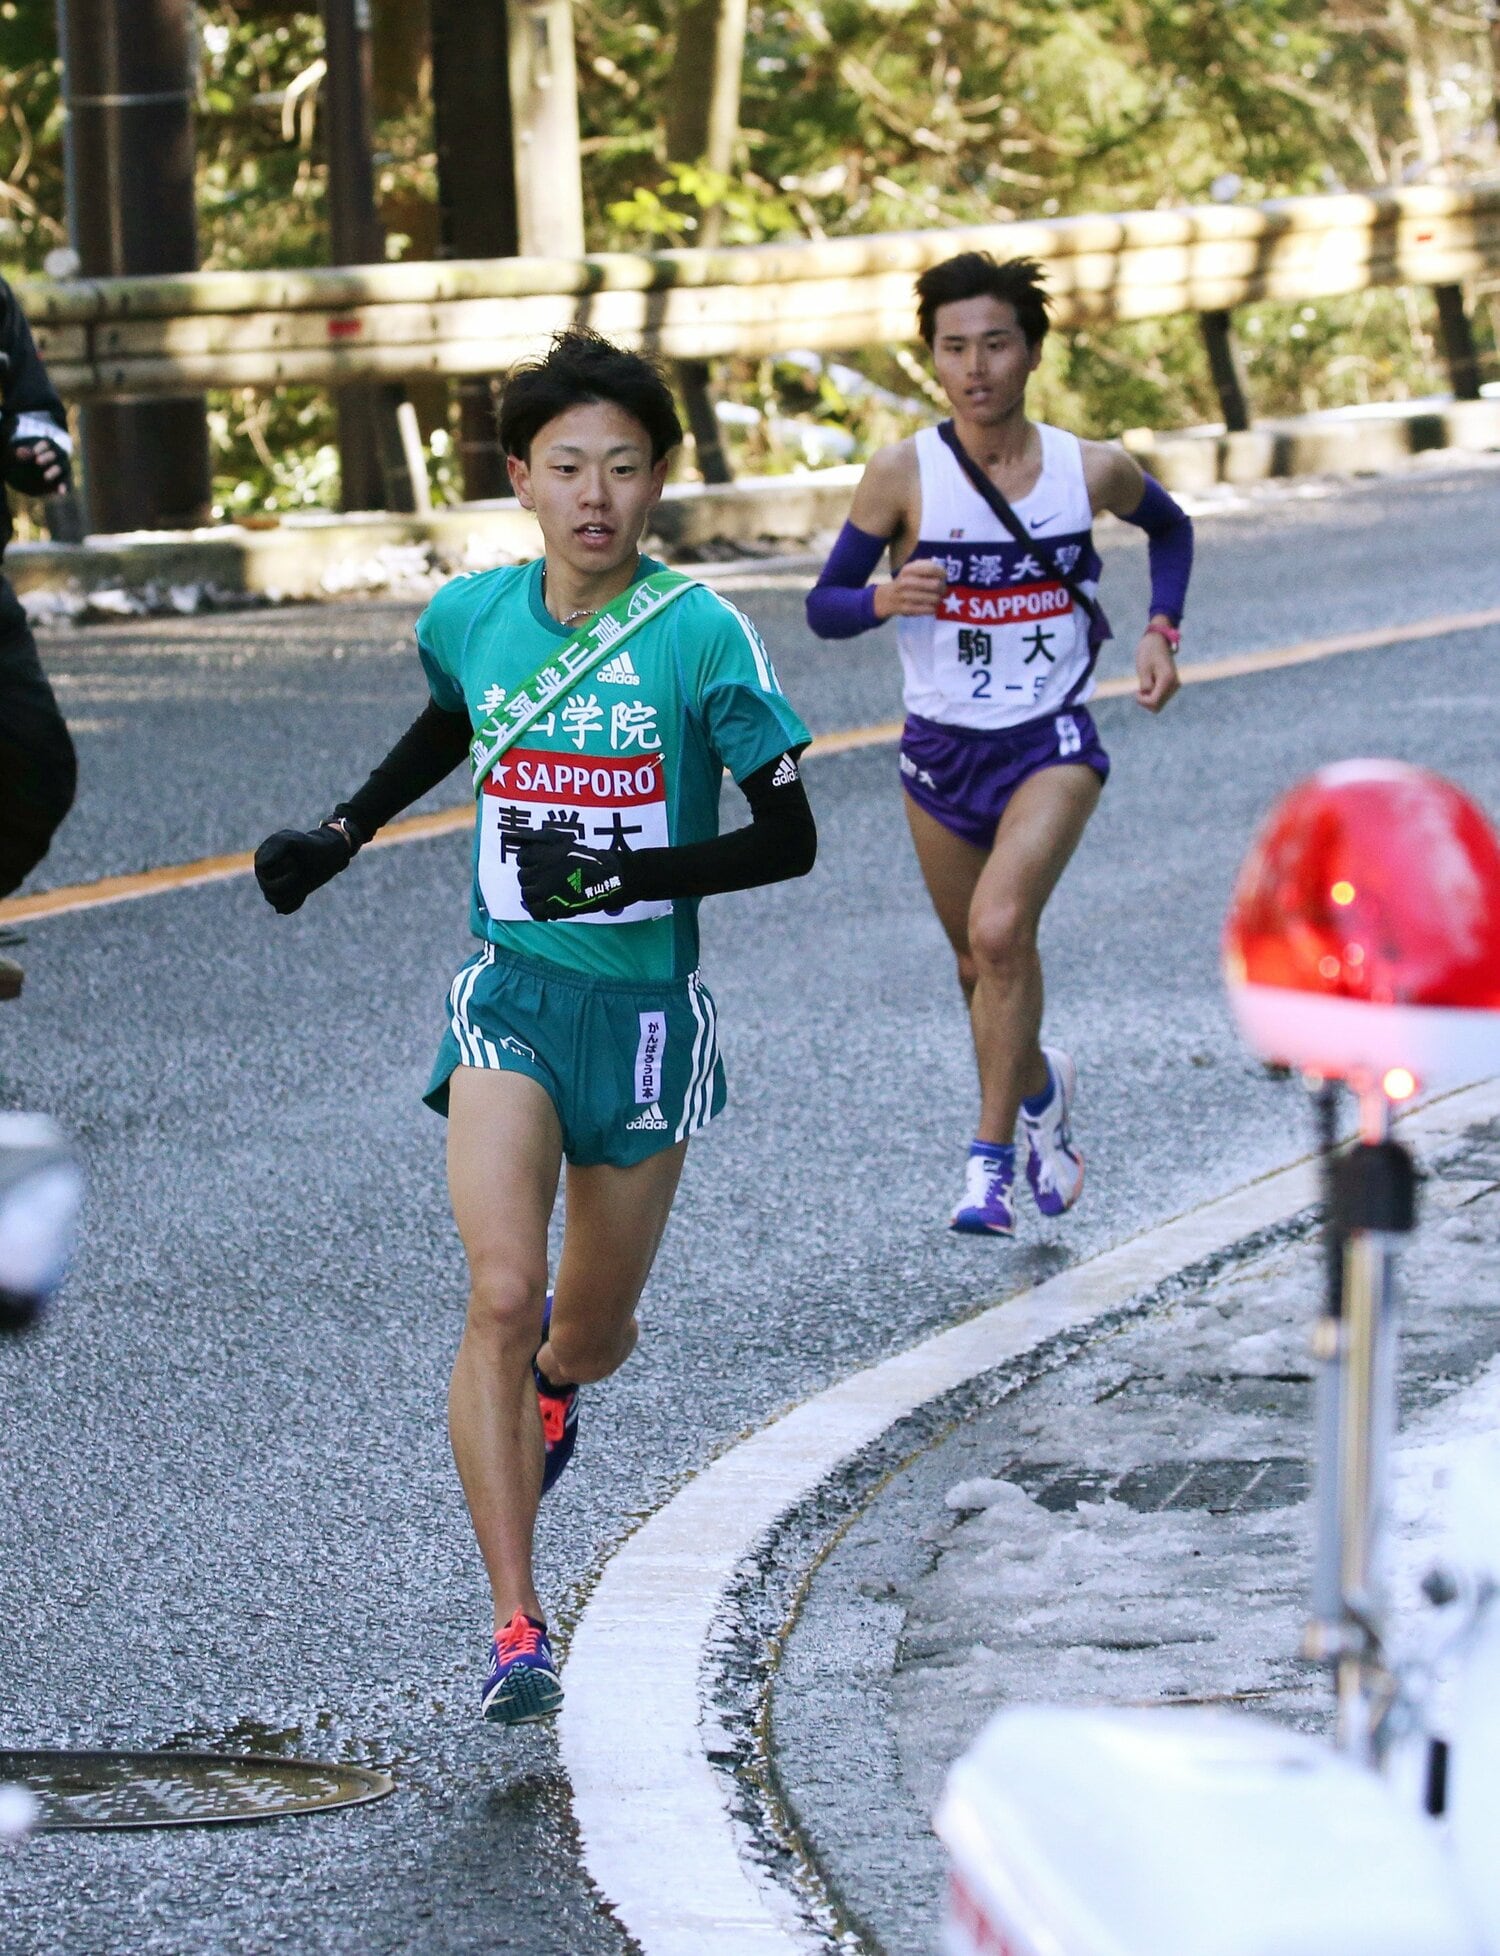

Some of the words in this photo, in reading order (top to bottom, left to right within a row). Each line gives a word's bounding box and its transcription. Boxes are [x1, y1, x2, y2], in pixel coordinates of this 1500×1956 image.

[968, 588, 1069, 619] SAPPORO
[596, 670, 640, 686] adidas
[515, 761, 656, 797] SAPPORO
[642, 1022, 659, 1099] がんばろう日本
[626, 1119, 668, 1130] adidas
